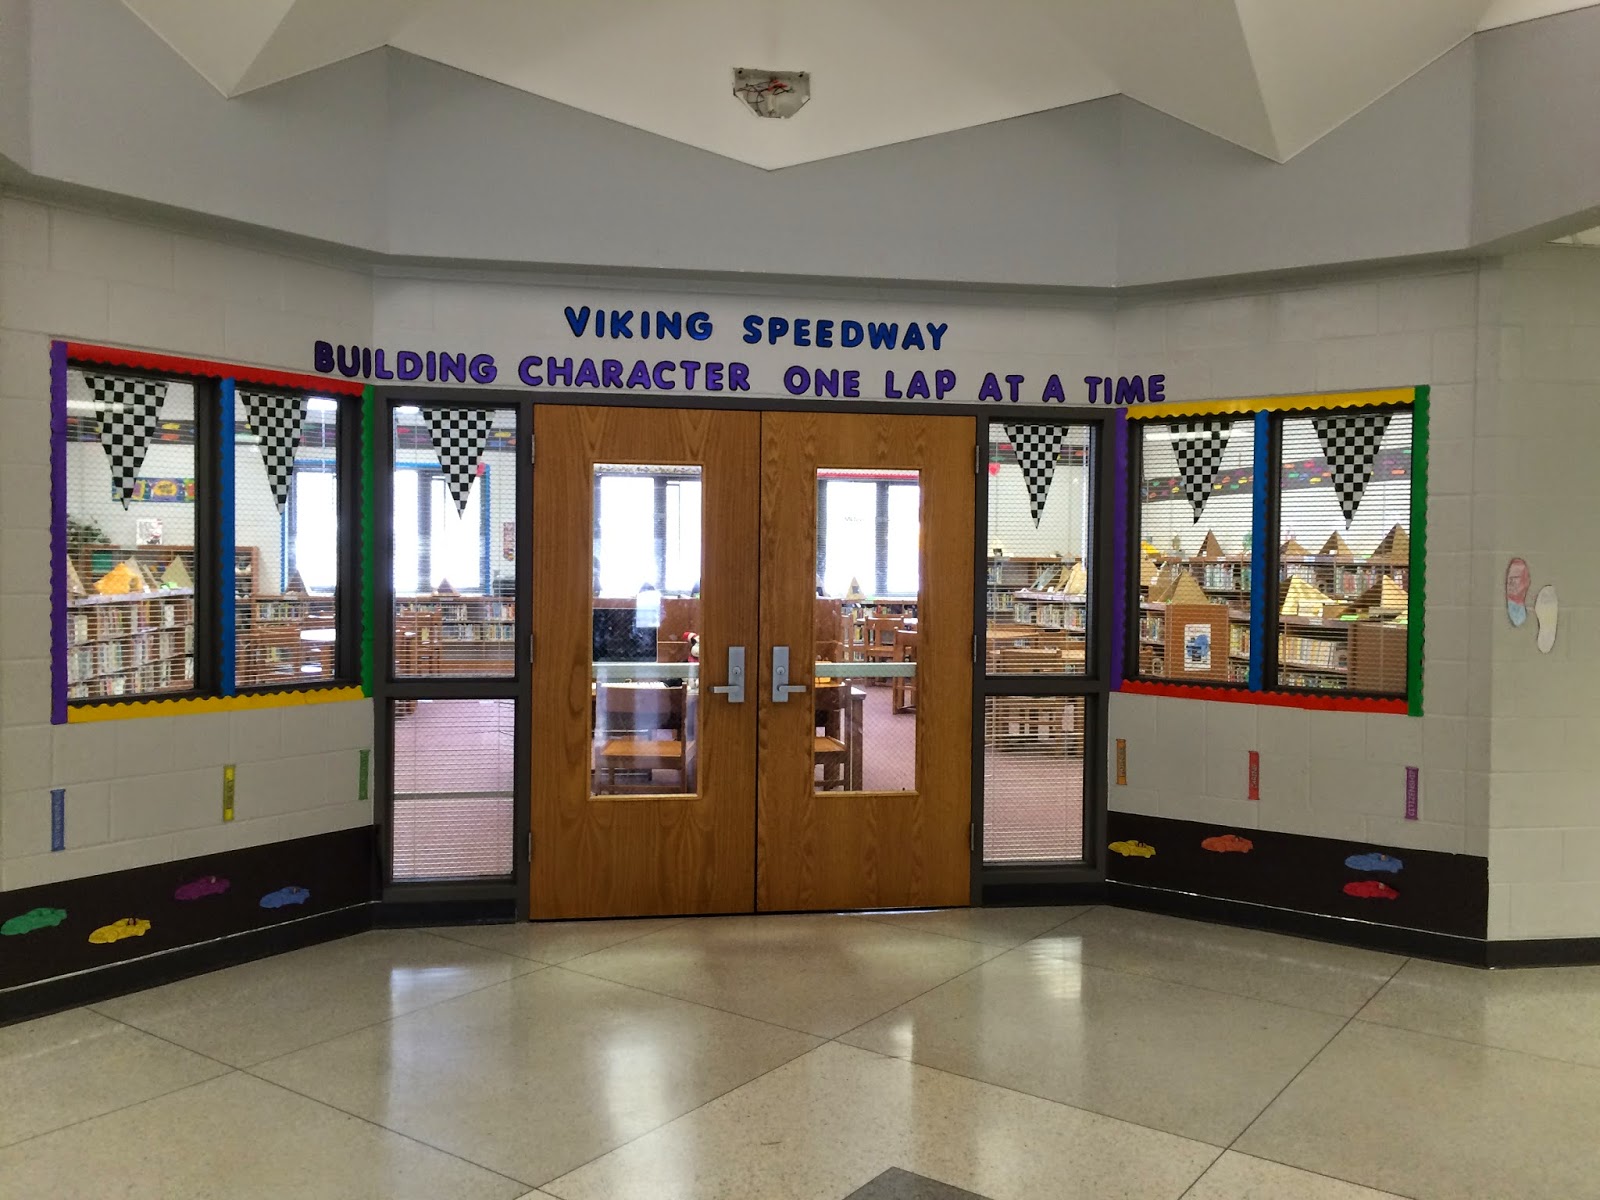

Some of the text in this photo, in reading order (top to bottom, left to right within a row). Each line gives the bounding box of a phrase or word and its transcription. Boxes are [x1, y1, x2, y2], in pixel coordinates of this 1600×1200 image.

[564, 306, 948, 350] VIKING SPEEDWAY
[314, 340, 1166, 405] BUILDING CHARACTER ONE LAP AT A TIME
[1407, 769, 1417, 817] CITIZENSHIP
